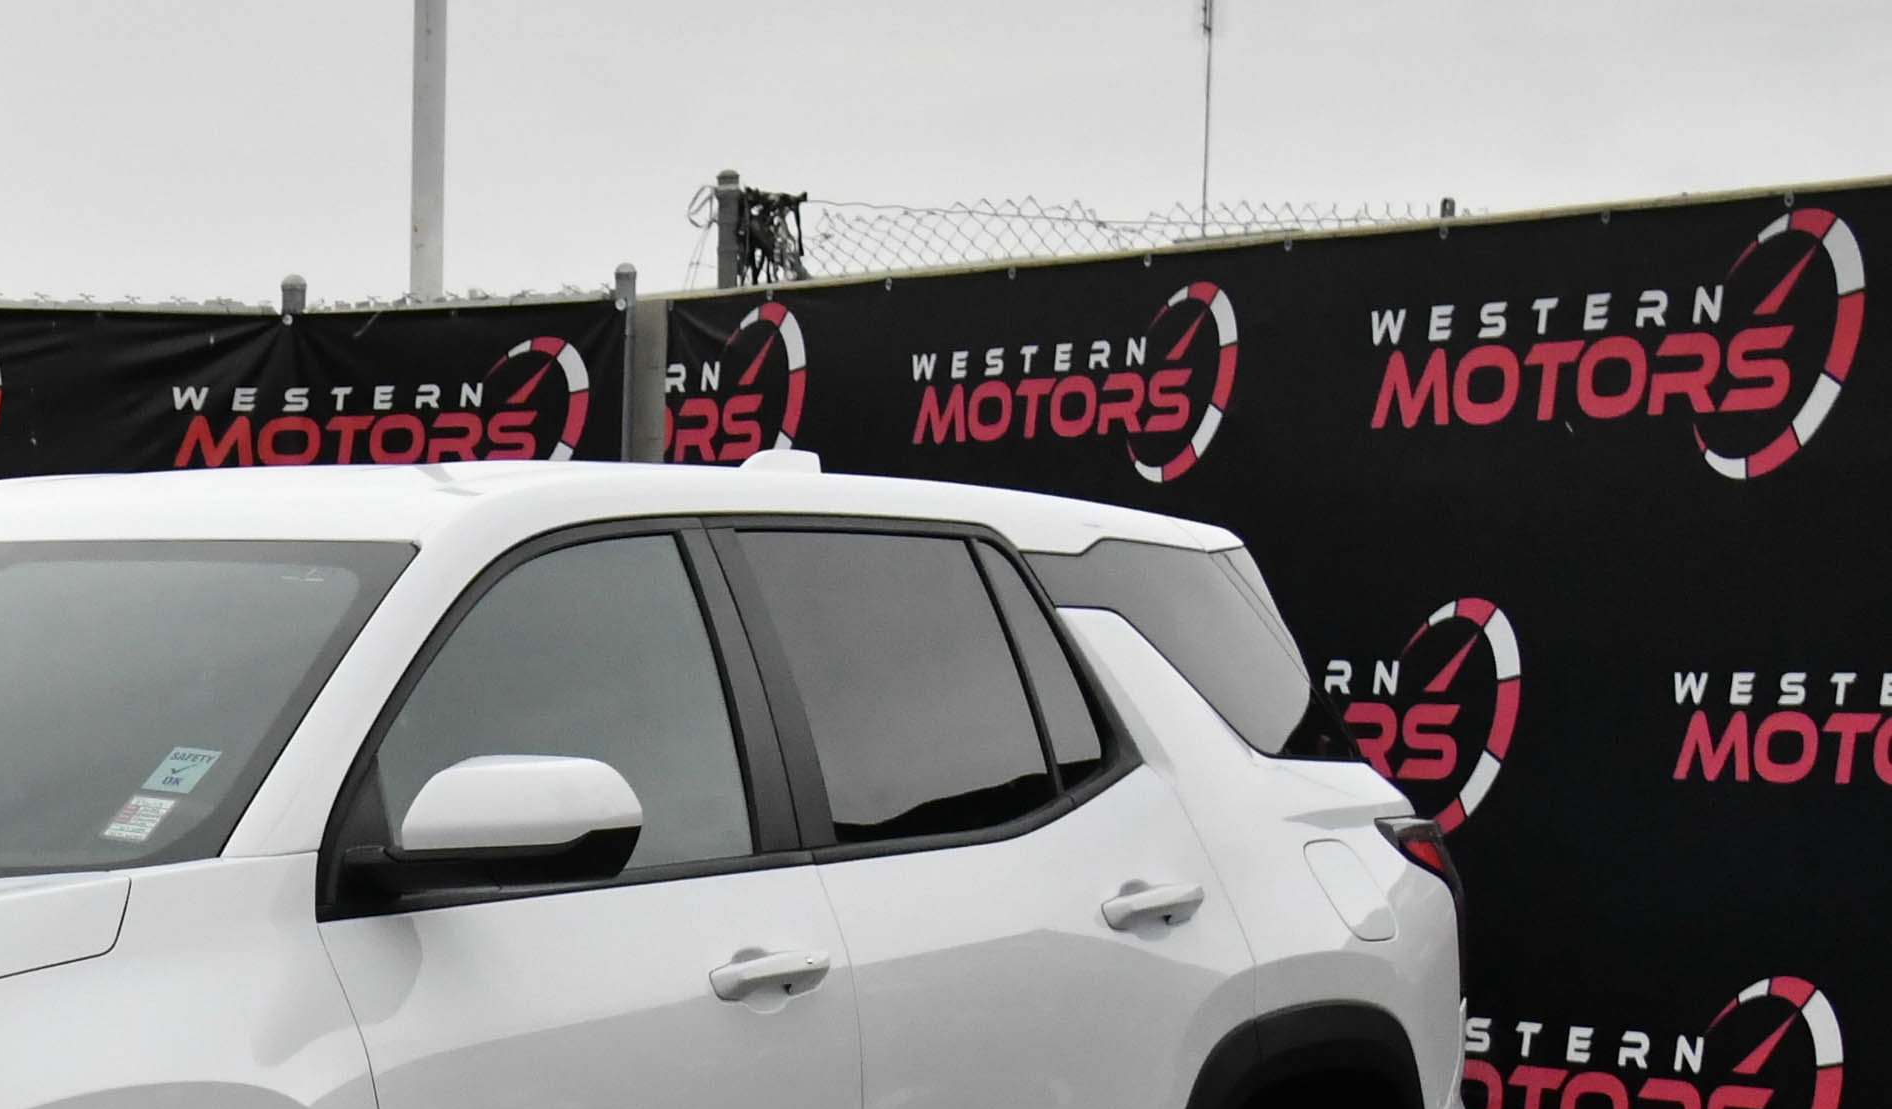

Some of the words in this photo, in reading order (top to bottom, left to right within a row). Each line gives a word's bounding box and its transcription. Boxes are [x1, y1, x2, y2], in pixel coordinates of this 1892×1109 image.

[1370, 284, 1725, 346] WESTERN
[911, 336, 1147, 382] WESTERN
[1370, 325, 1794, 429] MOTORS
[172, 382, 484, 412] WESTERN
[912, 368, 1193, 444] MOTORS
[174, 410, 538, 467] MOTORS
[664, 393, 764, 462] RS
[162, 776, 183, 786] OK
[171, 751, 215, 764] SAFETY
